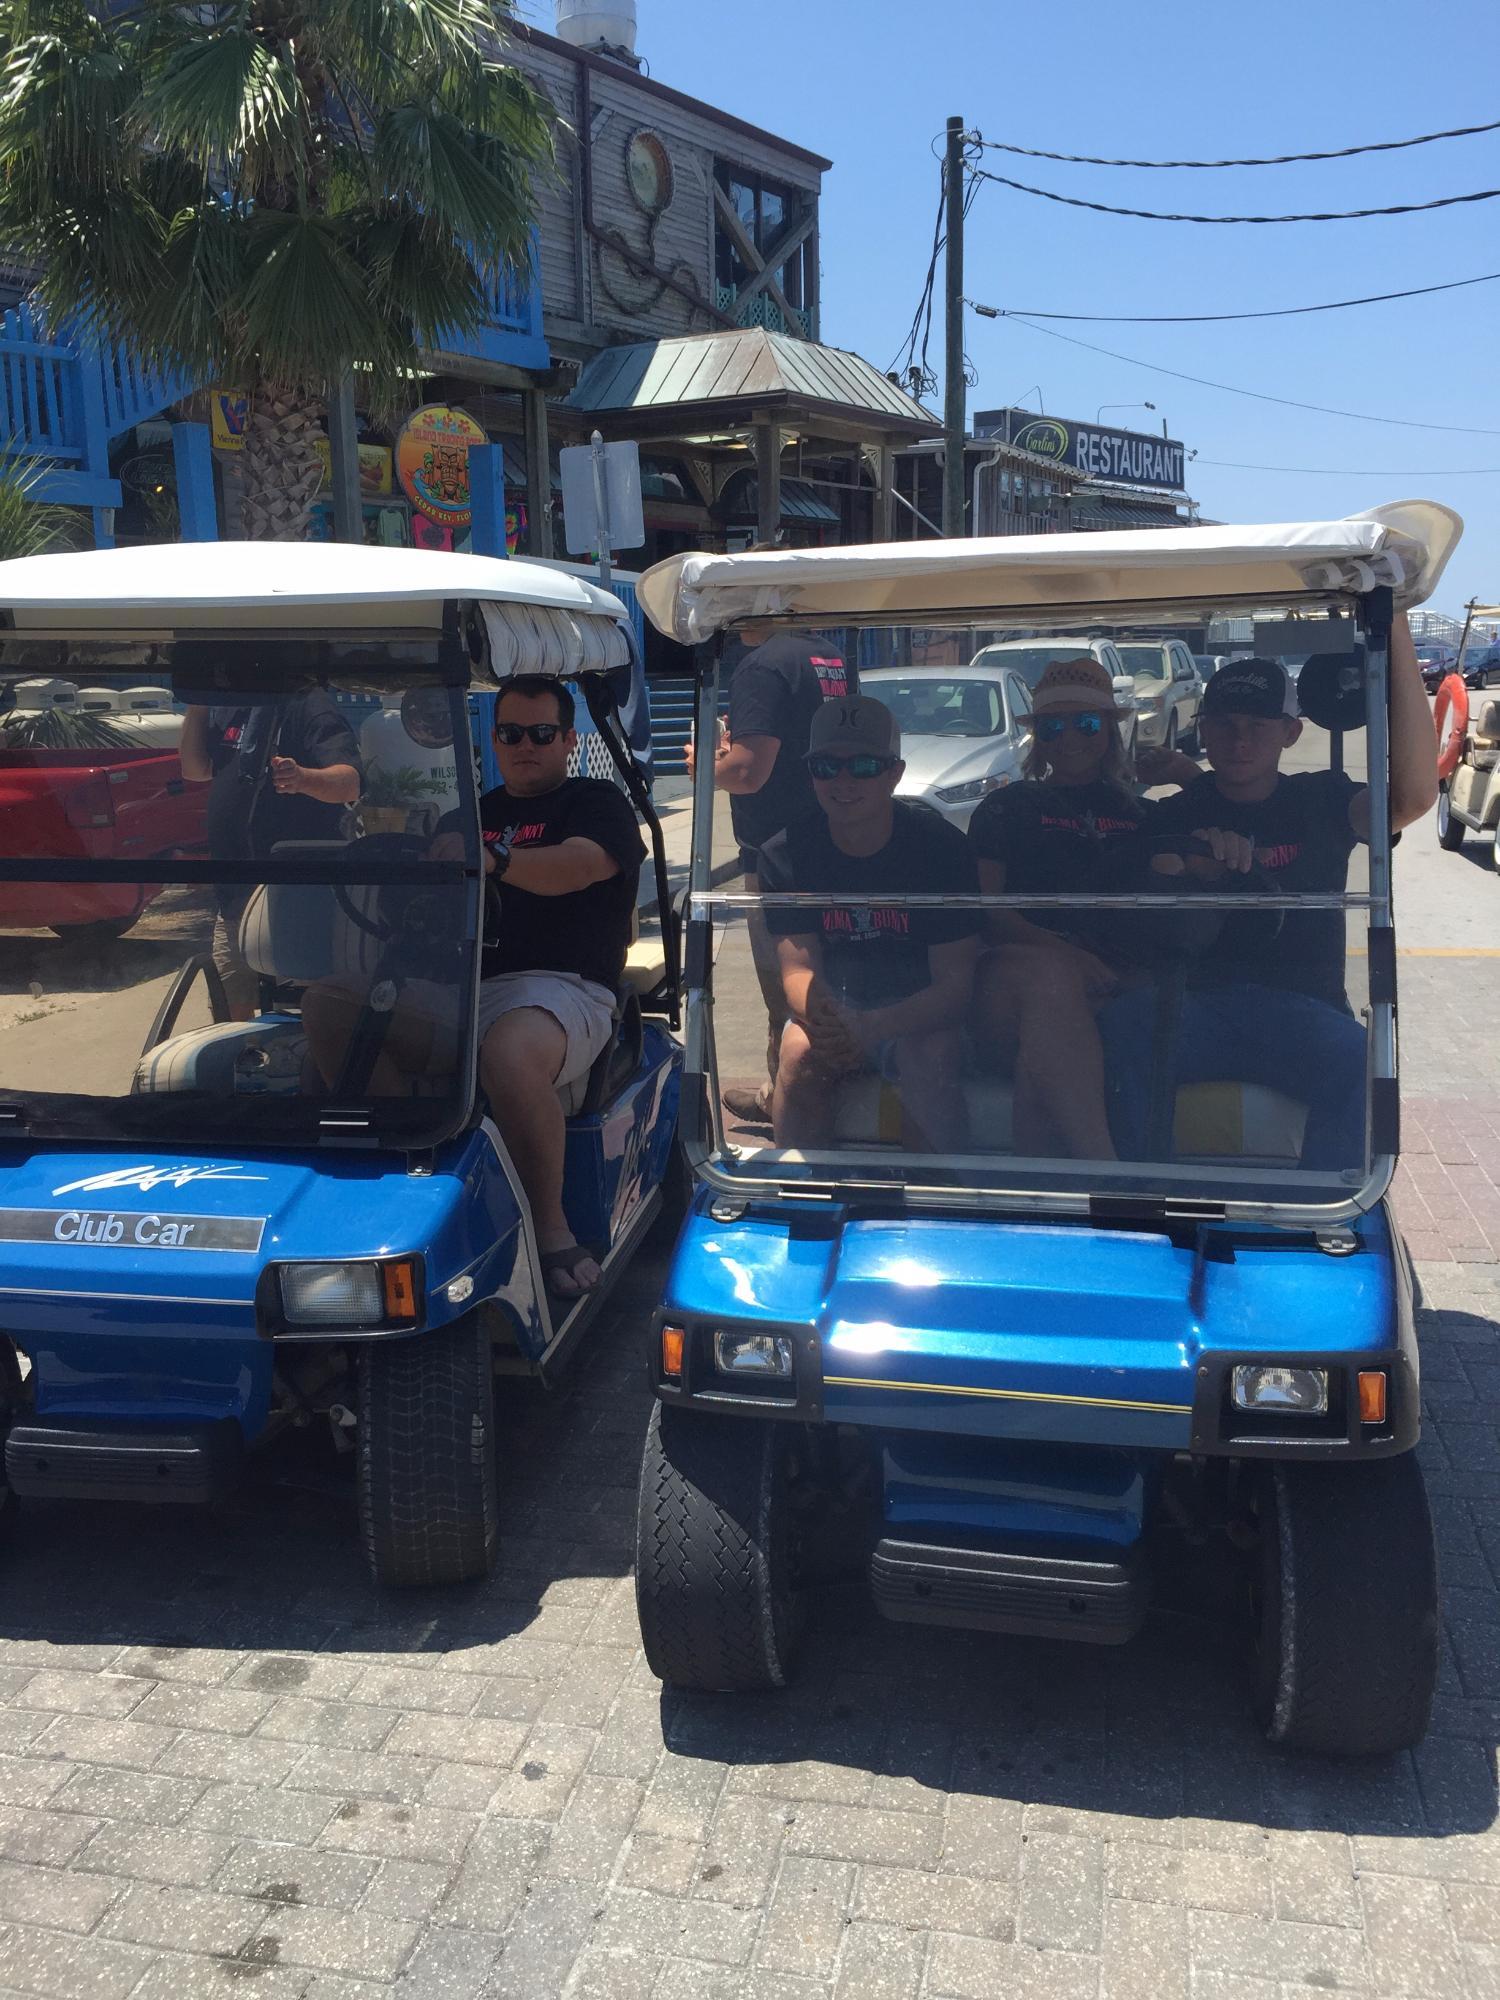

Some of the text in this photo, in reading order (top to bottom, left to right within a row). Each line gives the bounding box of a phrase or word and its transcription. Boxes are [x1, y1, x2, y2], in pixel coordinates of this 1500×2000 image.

[1076, 431, 1183, 483] RESTAURANT
[414, 496, 436, 517] CEDAR
[430, 766, 456, 779] WILSO
[53, 1211, 196, 1246] Club Car
